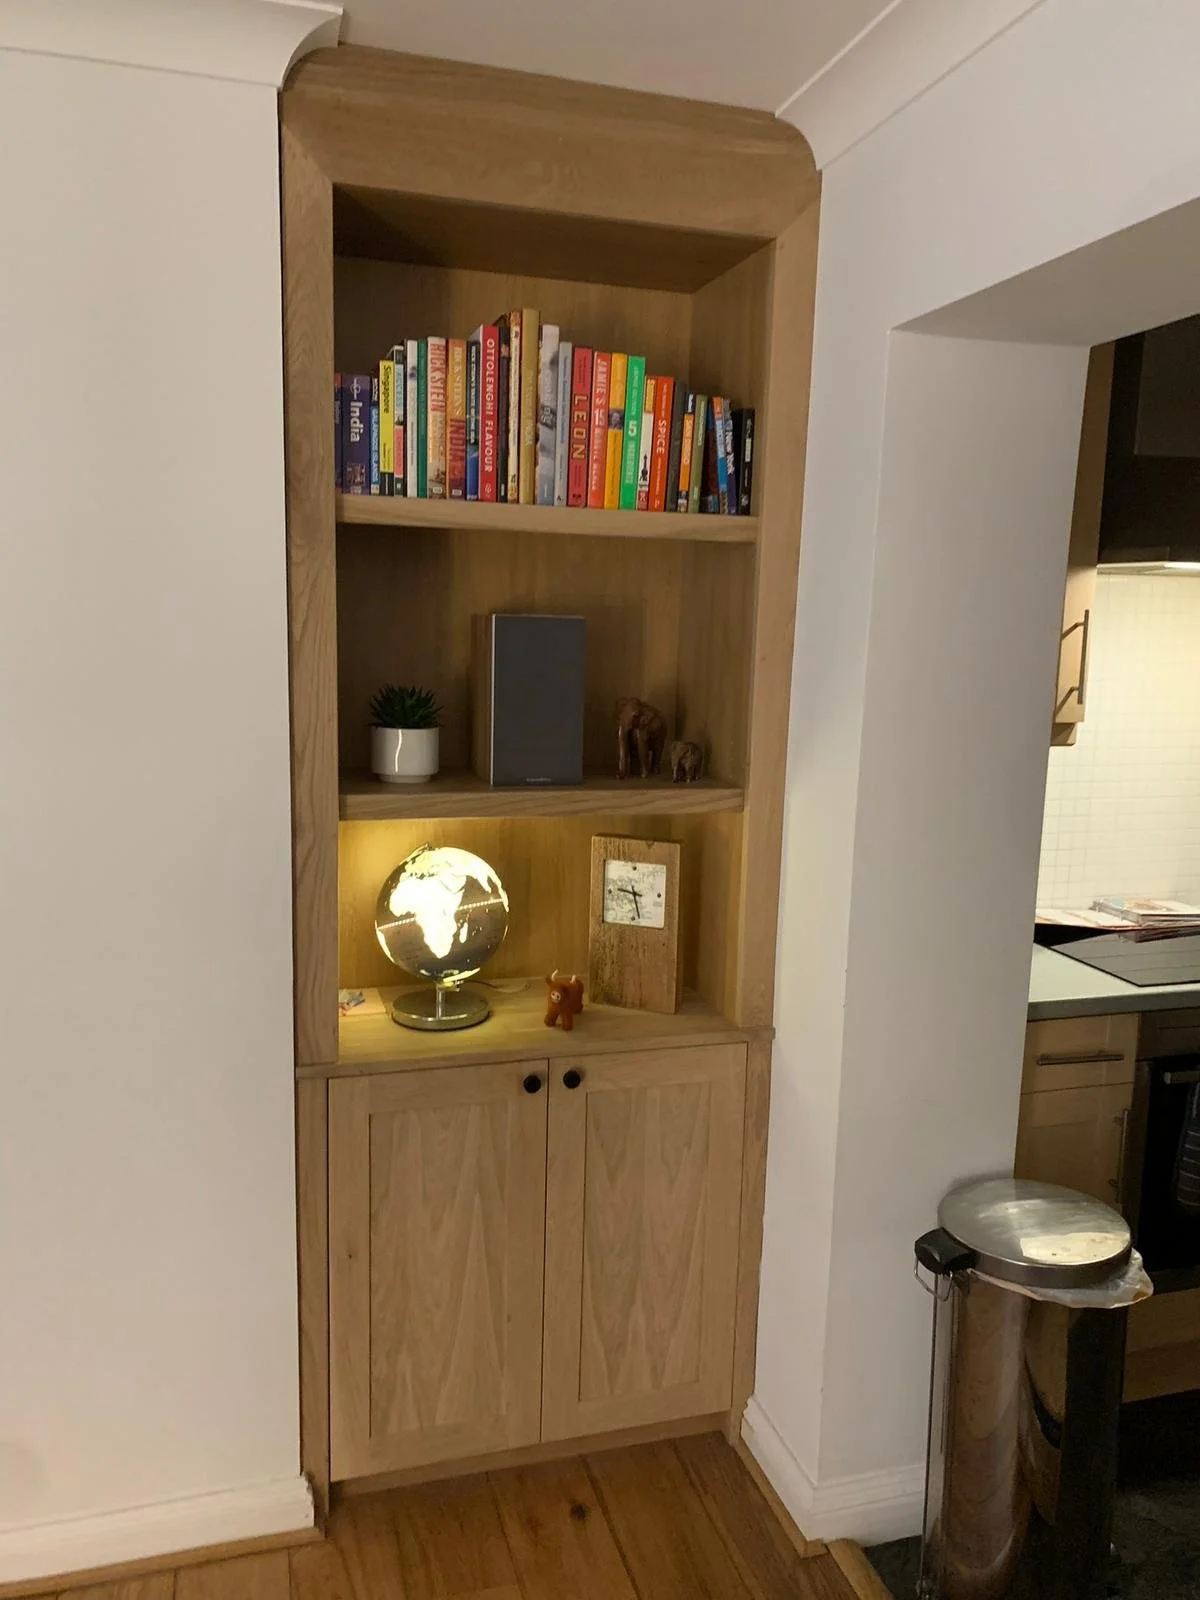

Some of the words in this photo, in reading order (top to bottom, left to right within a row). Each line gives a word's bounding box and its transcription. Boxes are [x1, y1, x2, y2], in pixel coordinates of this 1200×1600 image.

[430, 343, 445, 373] RICK
[454, 346, 463, 373] RICK
[486, 338, 495, 415] OTTOLENGHI
[382, 364, 392, 414] Singapore
[430, 375, 445, 412] STEIN
[453, 374, 463, 416] STEIN'S
[595, 358, 608, 405] JAMIE'S
[350, 401, 363, 442] India
[449, 419, 466, 463] INDIA
[573, 393, 588, 460] LEON
[628, 420, 638, 437] 5
[656, 419, 668, 455] SPICE
[484, 420, 494, 472] FLAVOUR
[371, 453, 379, 483] ISLANDS
